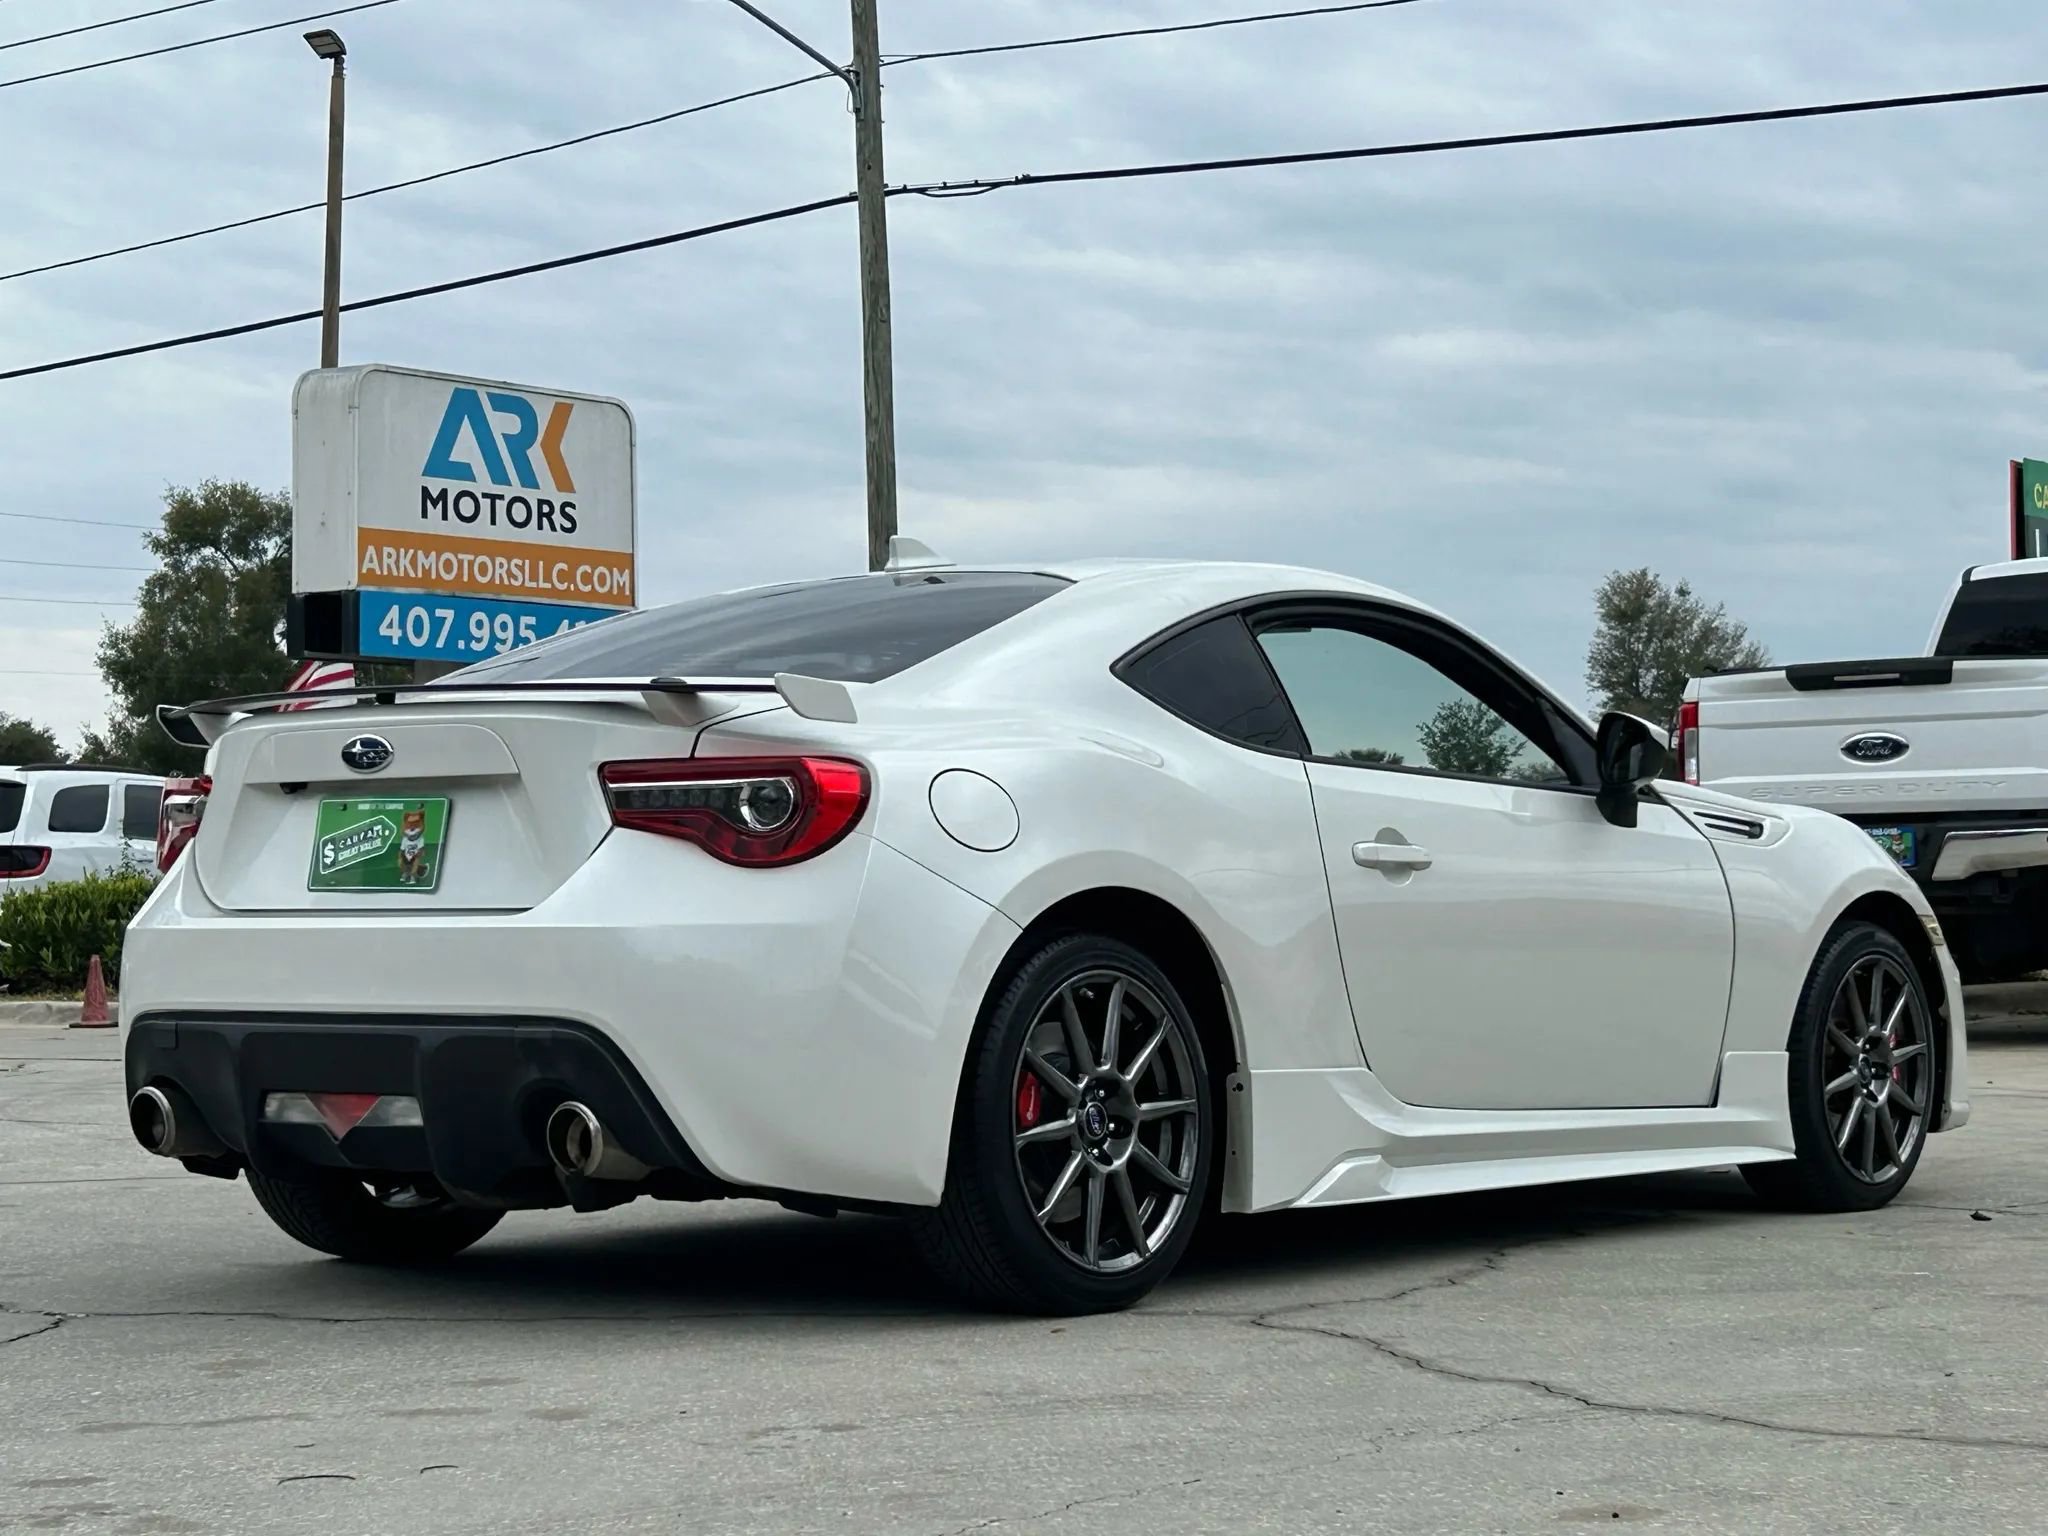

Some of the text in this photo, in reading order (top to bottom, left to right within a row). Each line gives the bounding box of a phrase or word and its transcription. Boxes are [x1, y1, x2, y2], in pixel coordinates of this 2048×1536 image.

[421, 387, 576, 493] ARK
[420, 485, 577, 534] MOTORS
[361, 545, 630, 596] ARKMOTORSLLC.COM
[1855, 739, 1893, 756] Ford
[1751, 779, 2007, 799] SUPER DUTY
